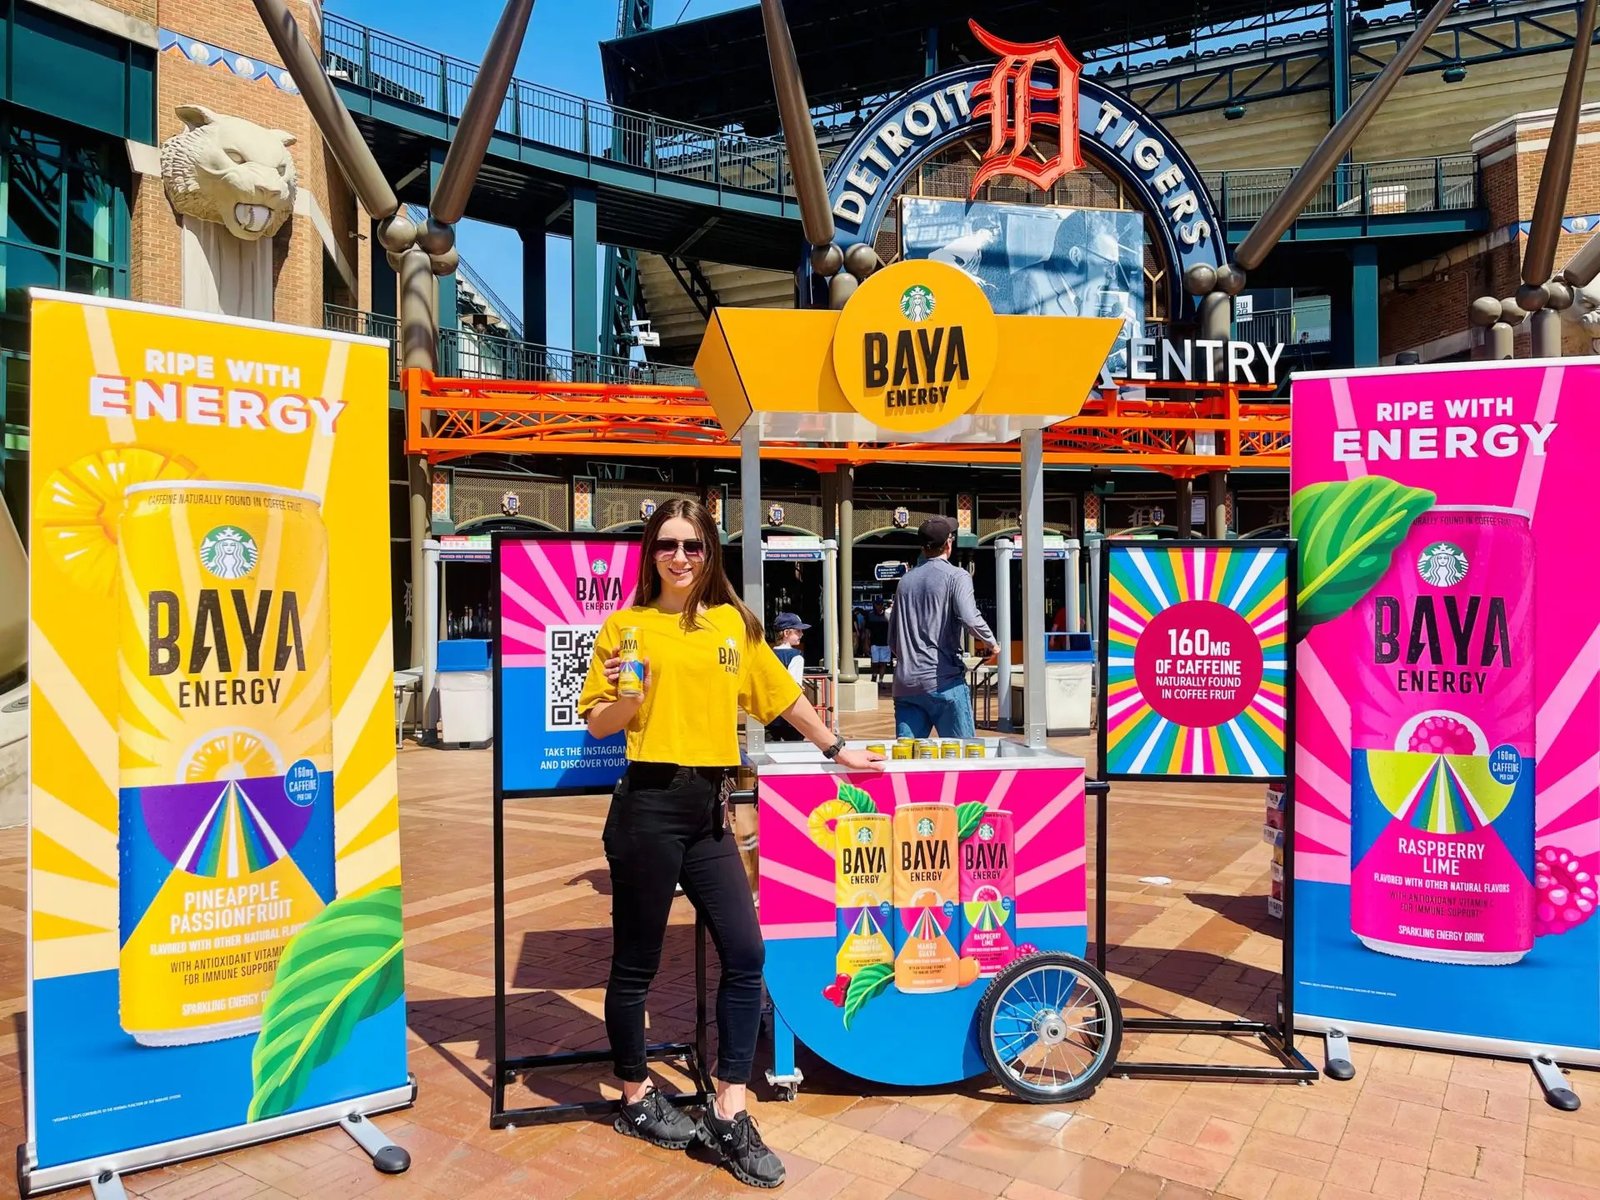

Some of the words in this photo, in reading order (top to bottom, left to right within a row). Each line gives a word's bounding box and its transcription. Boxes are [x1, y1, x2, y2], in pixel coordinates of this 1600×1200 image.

[833, 81, 970, 224] DETROIT
[1095, 100, 1211, 244] TIGERS
[145, 349, 214, 378] RIPE
[225, 360, 300, 388] WITH
[864, 326, 969, 388] BAYA
[1130, 338, 1285, 384] ENTRY
[89, 374, 348, 436] ENERGY
[886, 386, 949, 408] ENERGY
[1377, 401, 1434, 421] RIPE
[1444, 397, 1513, 419] WITH
[1333, 422, 1558, 462] ENERGY
[178, 493, 222, 505] NATURALLY
[225, 495, 251, 506] FOUND
[253, 497, 262, 507] IN
[576, 577, 623, 601] BAYA
[586, 602, 614, 611] ENERGY
[148, 588, 306, 676] BAYA
[1168, 628, 1230, 656] 160MG
[1374, 595, 1511, 668] BAYA
[719, 647, 740, 667] BAY
[1155, 659, 1172, 674] OF
[1177, 660, 1241, 675] CAFFEINE
[1156, 676, 1206, 687] NATURALLY
[1208, 677, 1241, 688] FOUND
[1398, 669, 1487, 694] ENERGY
[179, 679, 281, 708] ENERGY
[1162, 689, 1171, 699] IN
[1174, 689, 1207, 700] COFFEE
[1210, 690, 1236, 700] FRUIT
[544, 747, 564, 757] TAKE
[566, 747, 581, 756] THE
[540, 760, 559, 770] AND
[561, 759, 601, 769] DISCOVER
[603, 758, 625, 767] YOUR
[1492, 762, 1519, 773] CAFFEINE
[289, 779, 317, 793] CAFFEINE
[842, 846, 887, 874] BAYA
[902, 840, 950, 871] BAYA
[965, 843, 1008, 870] BAYA
[1398, 838, 1485, 860] RASPBERRY
[910, 871, 942, 882] ENERGY
[973, 870, 1001, 880] ENERGY
[1423, 857, 1460, 875] LIME
[851, 875, 880, 885] ENERGY
[1374, 872, 1403, 886] FLAVORED
[1405, 877, 1423, 888] WITH
[1425, 879, 1448, 890] OTHER
[1450, 882, 1482, 893] NATURAL
[1484, 883, 1510, 893] FLAVORS
[184, 880, 280, 912] PINEAPPLE
[170, 898, 293, 935] PASSIONFRUIT
[189, 938, 211, 952] WITH
[214, 934, 241, 948] OTHER
[244, 928, 280, 944] NATURAL
[1398, 925, 1435, 939] SPARKLING
[1436, 930, 1463, 941] ENERGY
[1464, 932, 1485, 943] DRINK
[171, 961, 191, 973] WITH
[194, 952, 251, 970] ANTIOXIDANT
[184, 973, 199, 985] FOR
[203, 968, 238, 983] IMMUNE
[182, 998, 226, 1016] SPARKLING
[228, 993, 259, 1009] ENERGY
